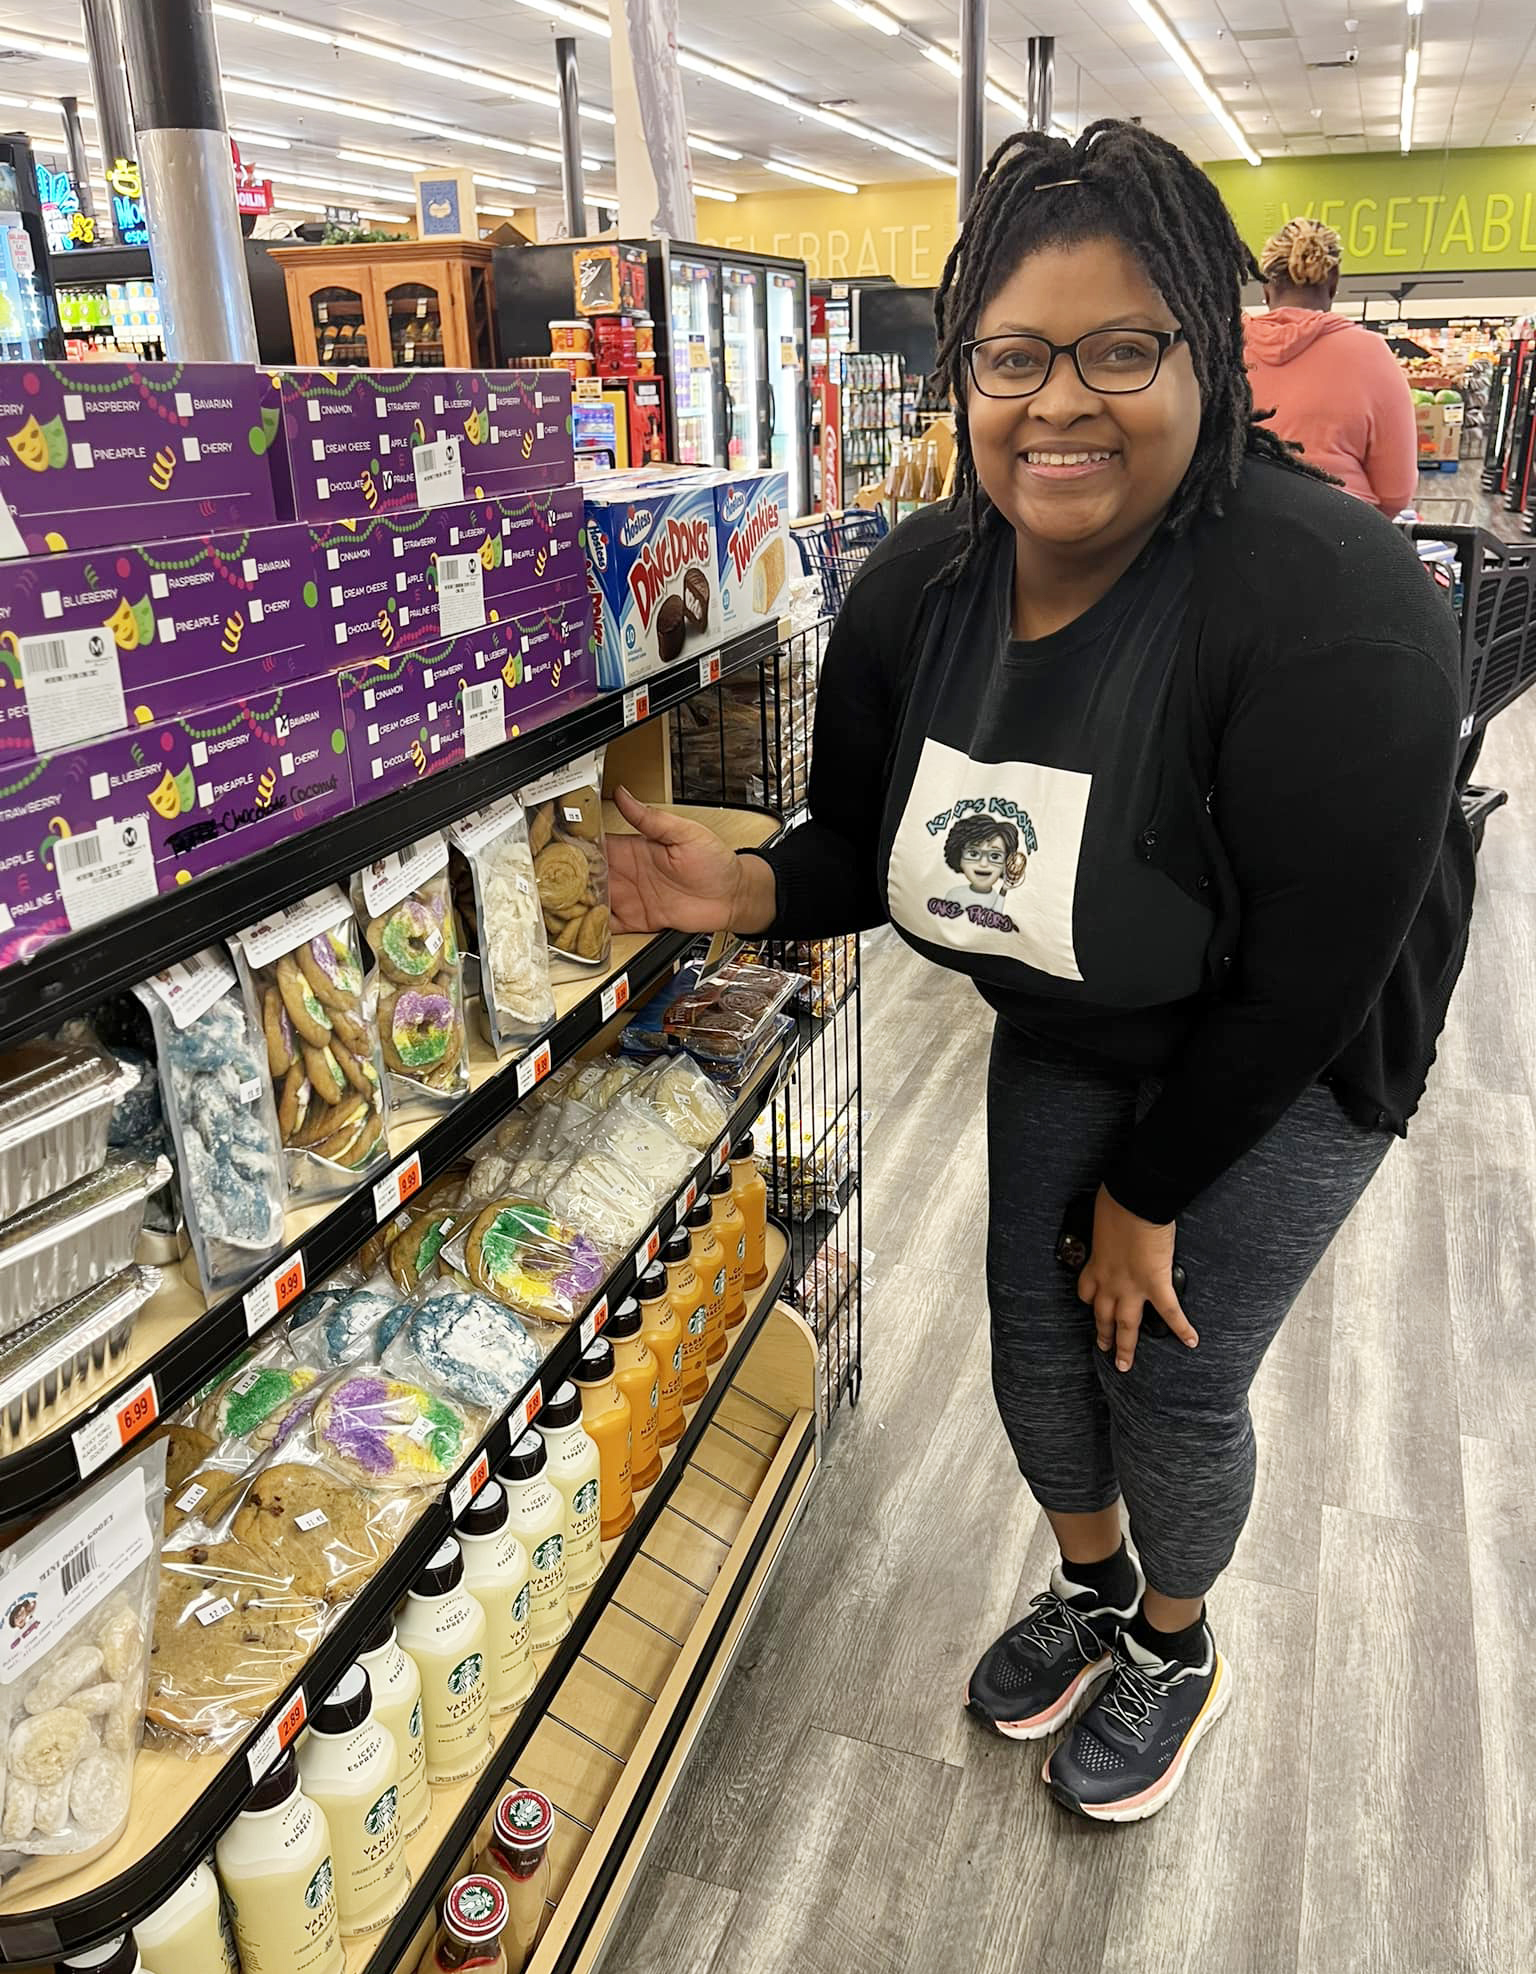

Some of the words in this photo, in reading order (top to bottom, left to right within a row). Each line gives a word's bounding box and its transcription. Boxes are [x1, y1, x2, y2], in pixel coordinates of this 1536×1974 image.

[85, 401, 140, 413] RASPBERRY
[194, 399, 233, 410] BAVARIAN
[321, 404, 352, 415] CINNAMON
[387, 401, 420, 412] STRAWBERRY
[444, 398, 472, 409] BLUEBERRY
[201, 443, 232, 454] CHERRY
[325, 442, 347, 454] CREAM
[347, 441, 371, 452] CHEESE
[390, 438, 408, 448] APPLE
[94, 447, 146, 460] PINEAPPLE
[330, 479, 365, 492] CHOCOLATE
[393, 473, 415, 484] PRALINE
[459, 527, 486, 539] BLUEBERRY
[624, 515, 651, 545] Hostess
[403, 537, 437, 550] STRAWBERRY
[667, 519, 711, 565] DONGS
[730, 500, 780, 583] Twinkies
[340, 549, 370, 561] CINNAMON
[258, 560, 290, 573] BAVARIAN
[169, 573, 215, 589] RASPBERRY
[407, 573, 424, 584] APPLE
[63, 588, 118, 608] BLUEBERRY
[344, 586, 365, 599] CREAM
[365, 582, 388, 594] CHEESE
[264, 600, 290, 613] CHERRY
[410, 607, 430, 619] PRALINE
[176, 614, 220, 632] PINEAPPLE
[347, 619, 381, 635] CHOCOLATE
[484, 647, 508, 663] BLUEBERRY
[433, 663, 464, 681] STRAWBERRY
[376, 684, 403, 700] CINNAMON
[437, 700, 453, 713] APPLE
[289, 711, 320, 728] BAVARIAN
[379, 719, 399, 736] CREAM
[399, 712, 421, 728] CHEESE
[208, 734, 250, 755] RASPBERRY
[440, 730, 460, 744] PRALINE
[294, 749, 320, 766] CHERRY
[383, 748, 414, 770] CHOCOLATE
[109, 761, 163, 787] BLUEBERRY
[214, 773, 254, 795] PINEAPPLE
[290, 774, 338, 804] Coconut
[0, 793, 62, 821] TRAWBERRY
[10, 893, 54, 918] PRALINE
[402, 1171, 417, 1193] 9.99
[280, 1273, 298, 1300] 9.99
[124, 1397, 148, 1429] 6.99
[530, 1494, 545, 1506] ICED
[576, 1516, 598, 1536] LATTE
[531, 1562, 566, 1585] VANILLA
[537, 1573, 563, 1592] LATTE
[445, 1610, 463, 1624] ICED
[446, 1682, 486, 1713] VANILLA
[453, 1693, 482, 1719] LATTE
[358, 1742, 375, 1760] ICED
[292, 1813, 307, 1833] ICED
